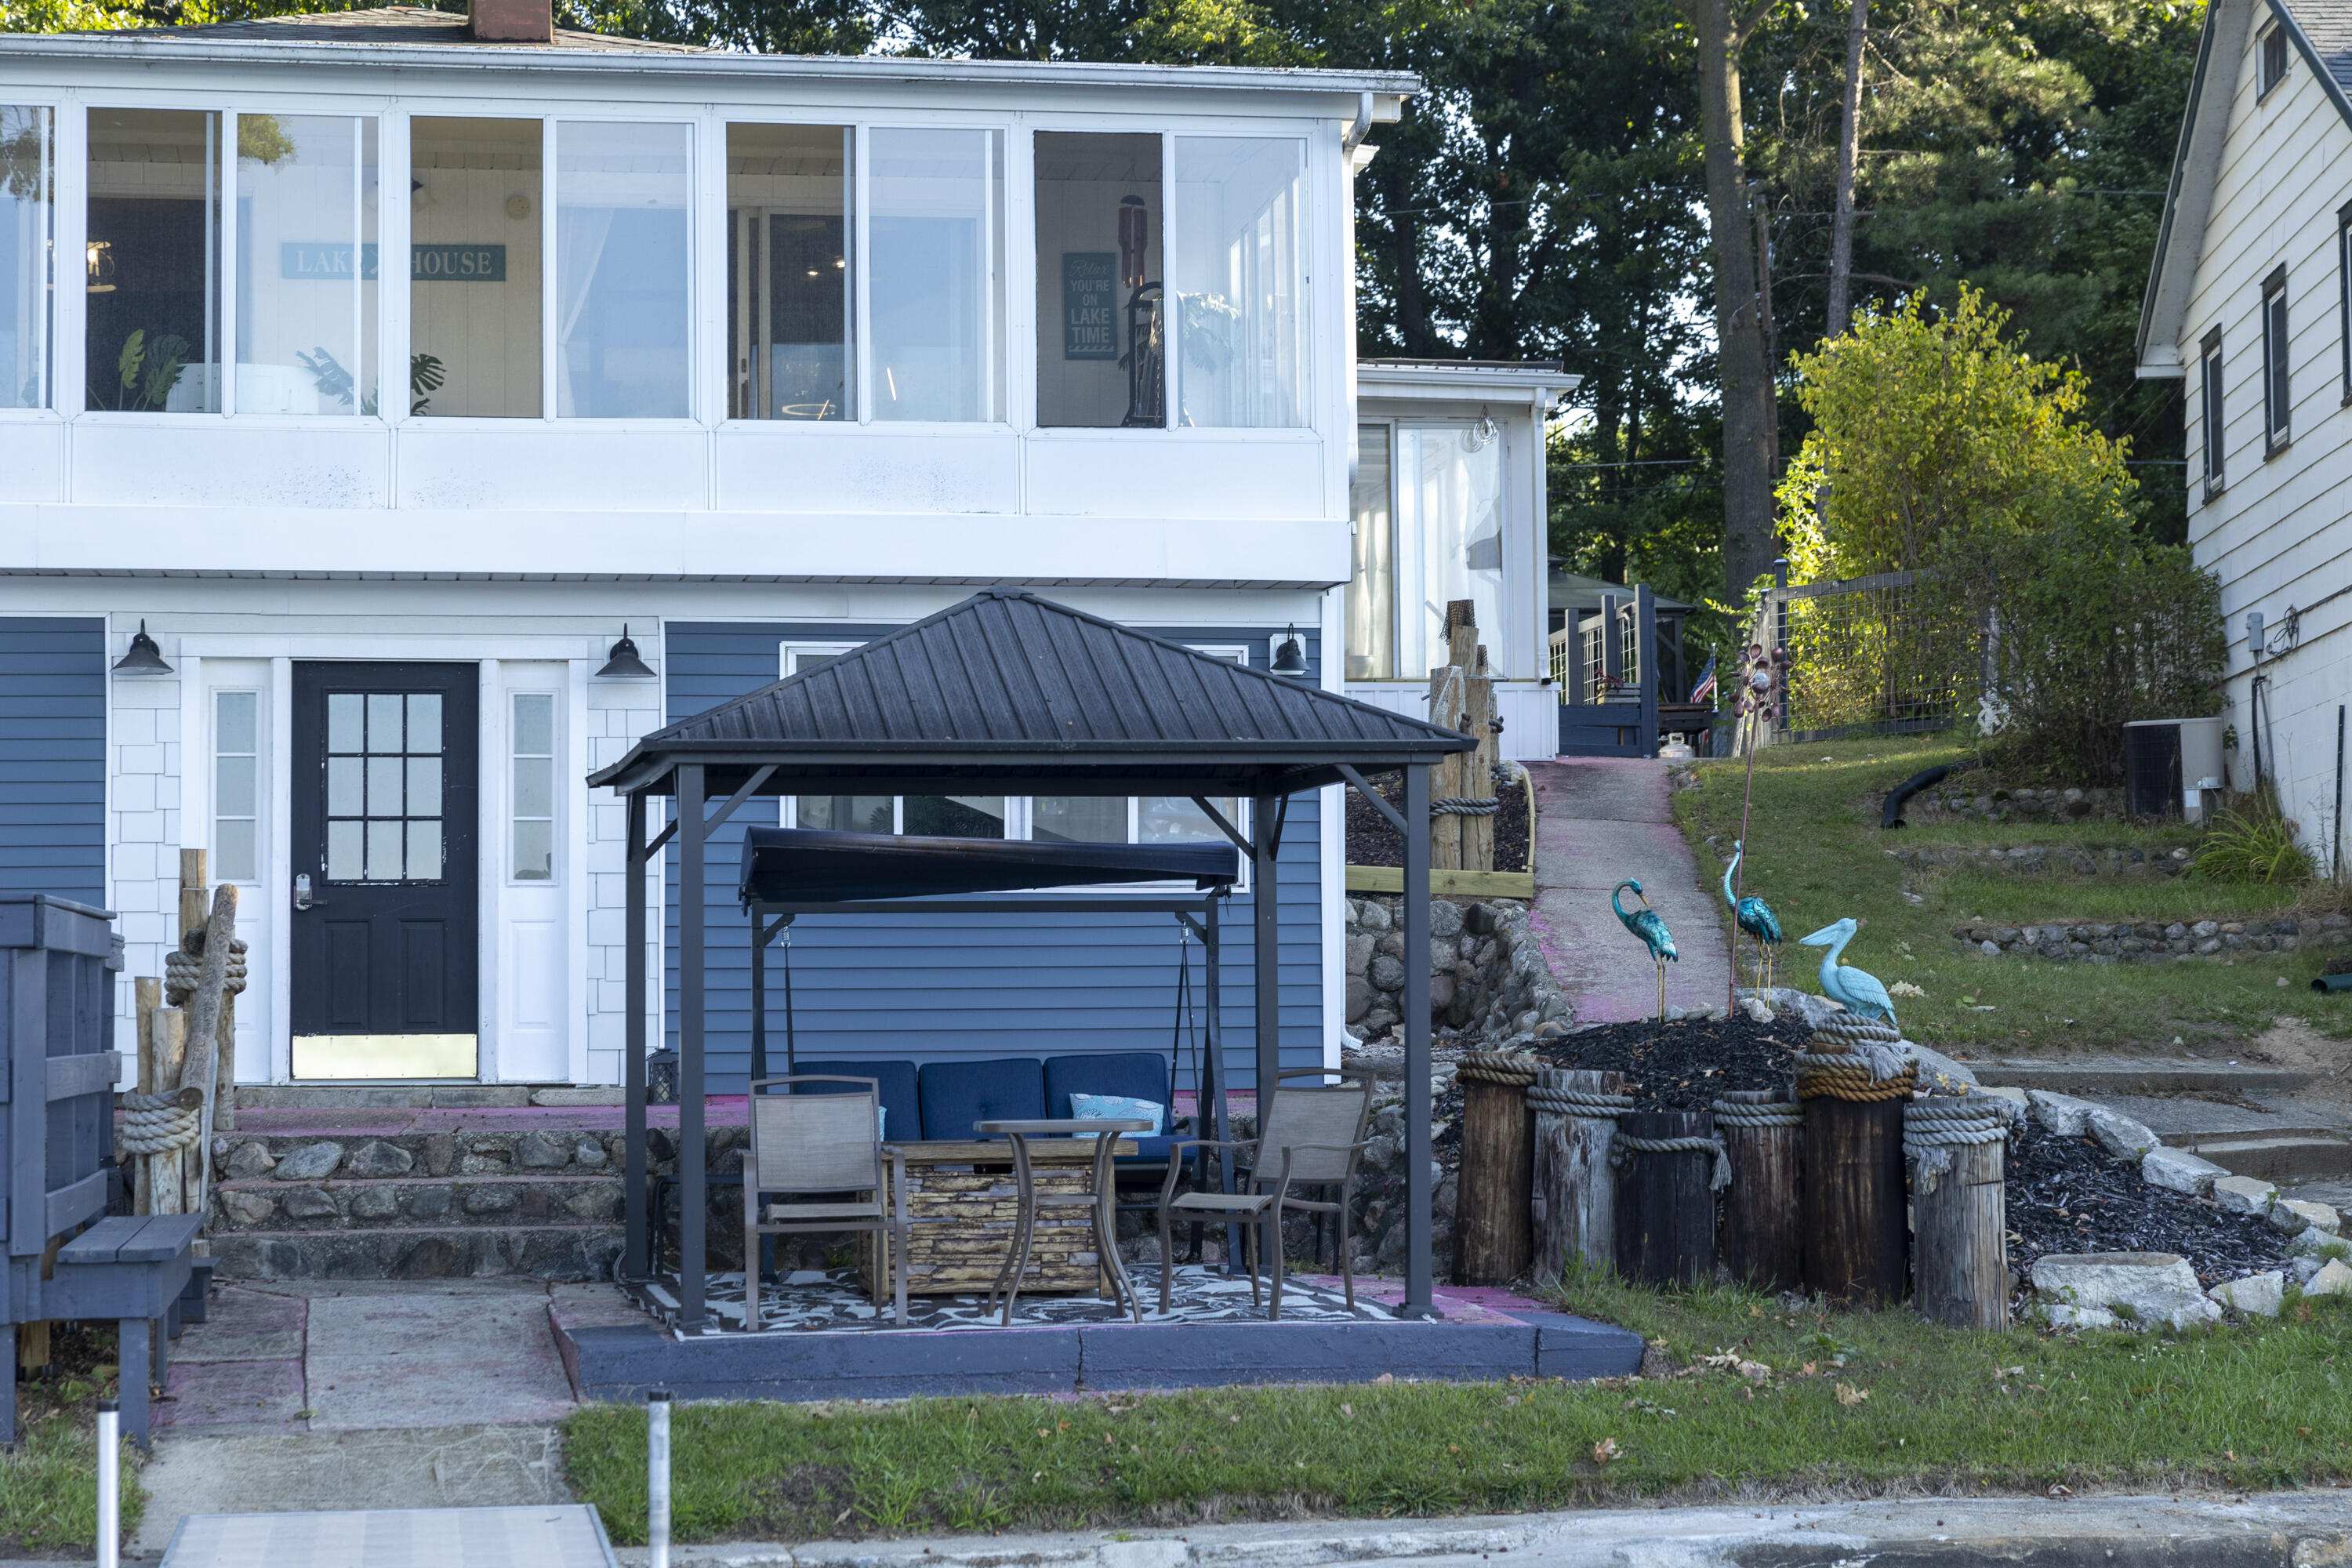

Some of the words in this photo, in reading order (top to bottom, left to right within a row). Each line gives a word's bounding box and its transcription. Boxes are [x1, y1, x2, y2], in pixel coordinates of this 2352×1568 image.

[1069, 260, 1110, 277] Relax
[1070, 279, 1110, 292] YOU'RE
[1082, 294, 1098, 306] ON
[1071, 308, 1110, 325] LAKE
[1071, 327, 1110, 343] TIME
